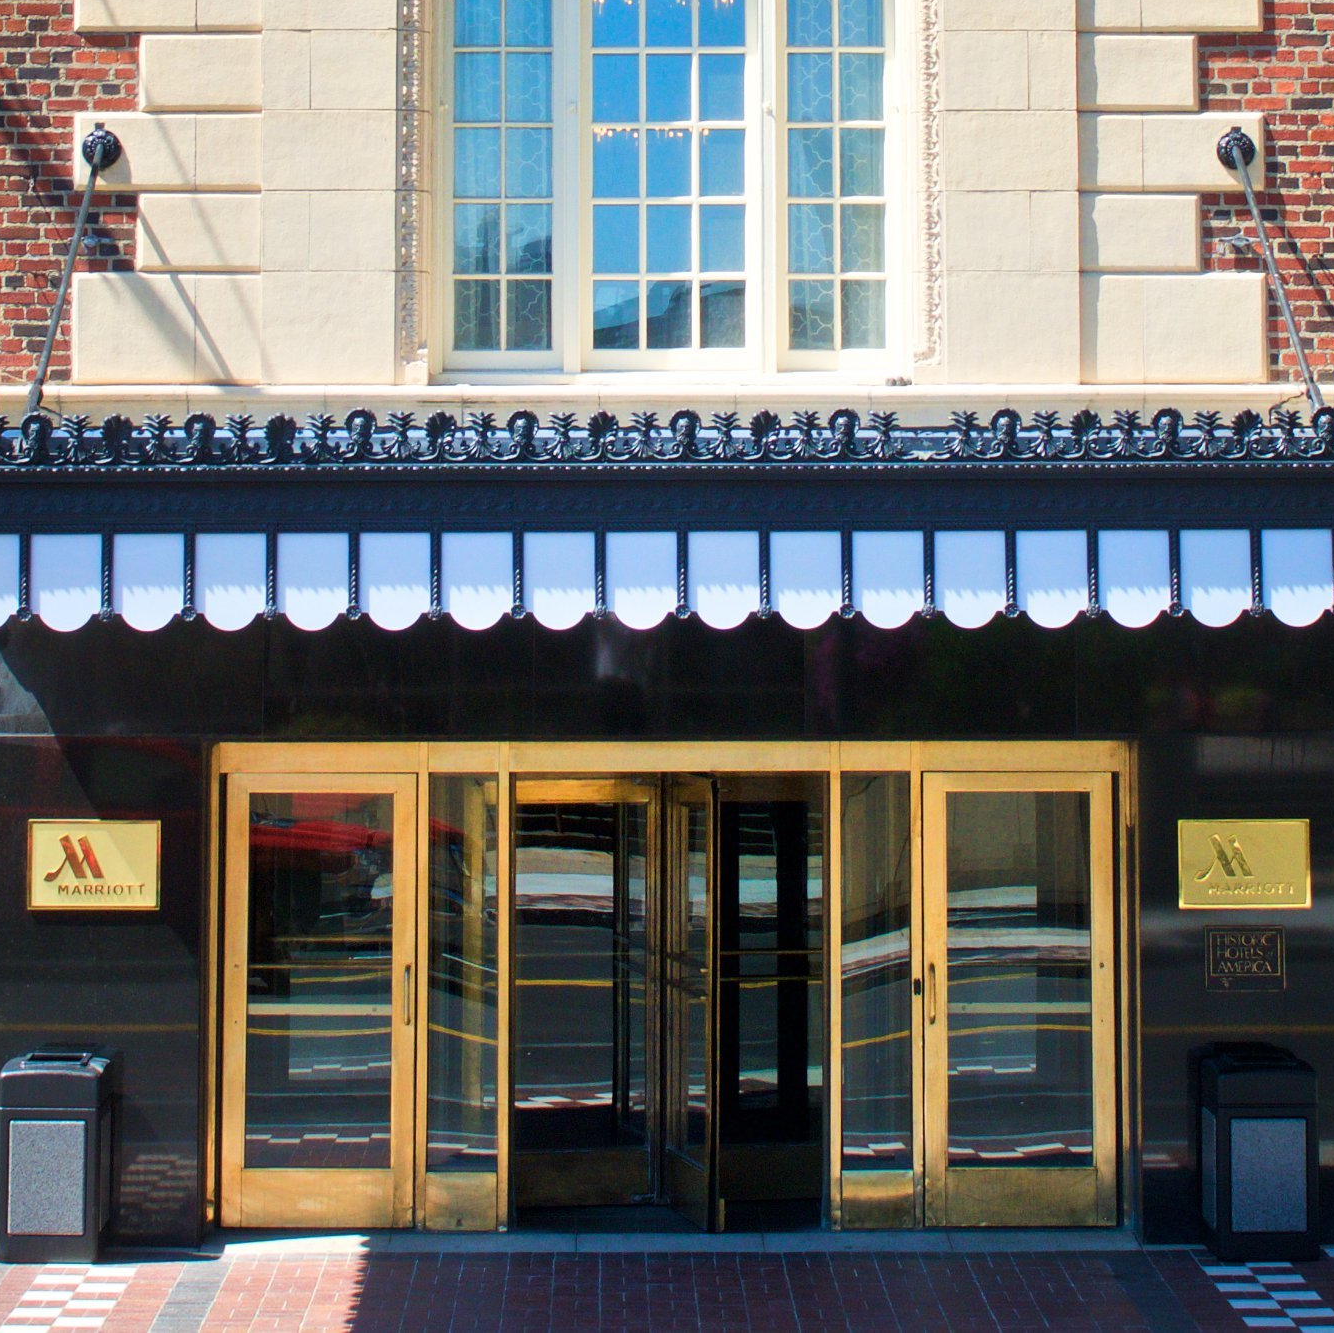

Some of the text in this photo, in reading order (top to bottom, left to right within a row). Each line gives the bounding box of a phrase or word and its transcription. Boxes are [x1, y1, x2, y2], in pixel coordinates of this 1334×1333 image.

[58, 883, 145, 896] MARRIOTT
[1208, 882, 1295, 896] MARRIOTT
[1216, 933, 1272, 946] HISTORIC
[1217, 946, 1264, 959] HOTELS
[1217, 960, 1272, 973] AMERICA
